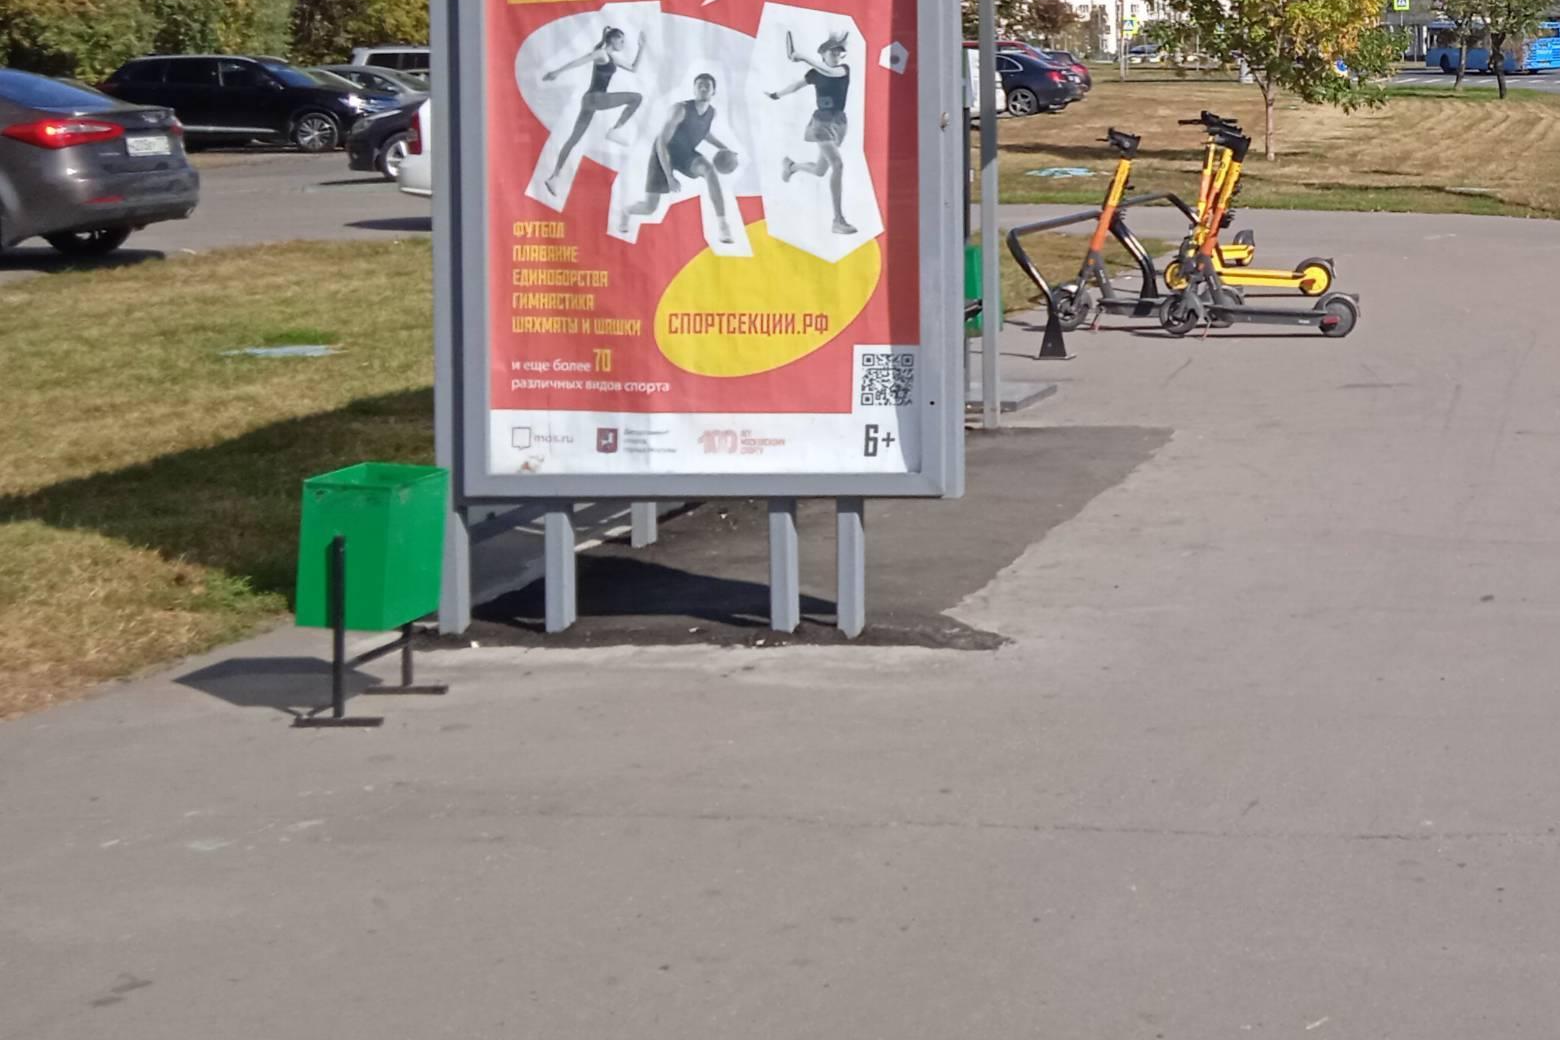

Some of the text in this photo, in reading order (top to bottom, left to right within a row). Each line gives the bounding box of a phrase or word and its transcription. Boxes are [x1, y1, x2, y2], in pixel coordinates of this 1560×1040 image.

[512, 220, 565, 239] ФУТБОЛ
[512, 245, 579, 263] ПЛАВАНИЕ
[512, 268, 609, 287] ЕДИНОБОРСТВА
[512, 292, 595, 311] ГИМНАСТИКА
[511, 316, 642, 336] ШАХМАТЫ И ШАШКИ
[667, 312, 830, 337] СПОРТСЕКЦИИ.РФ
[511, 348, 612, 373] и еще более 70
[511, 378, 671, 395] различных видов спорта
[863, 424, 896, 457] 6+
